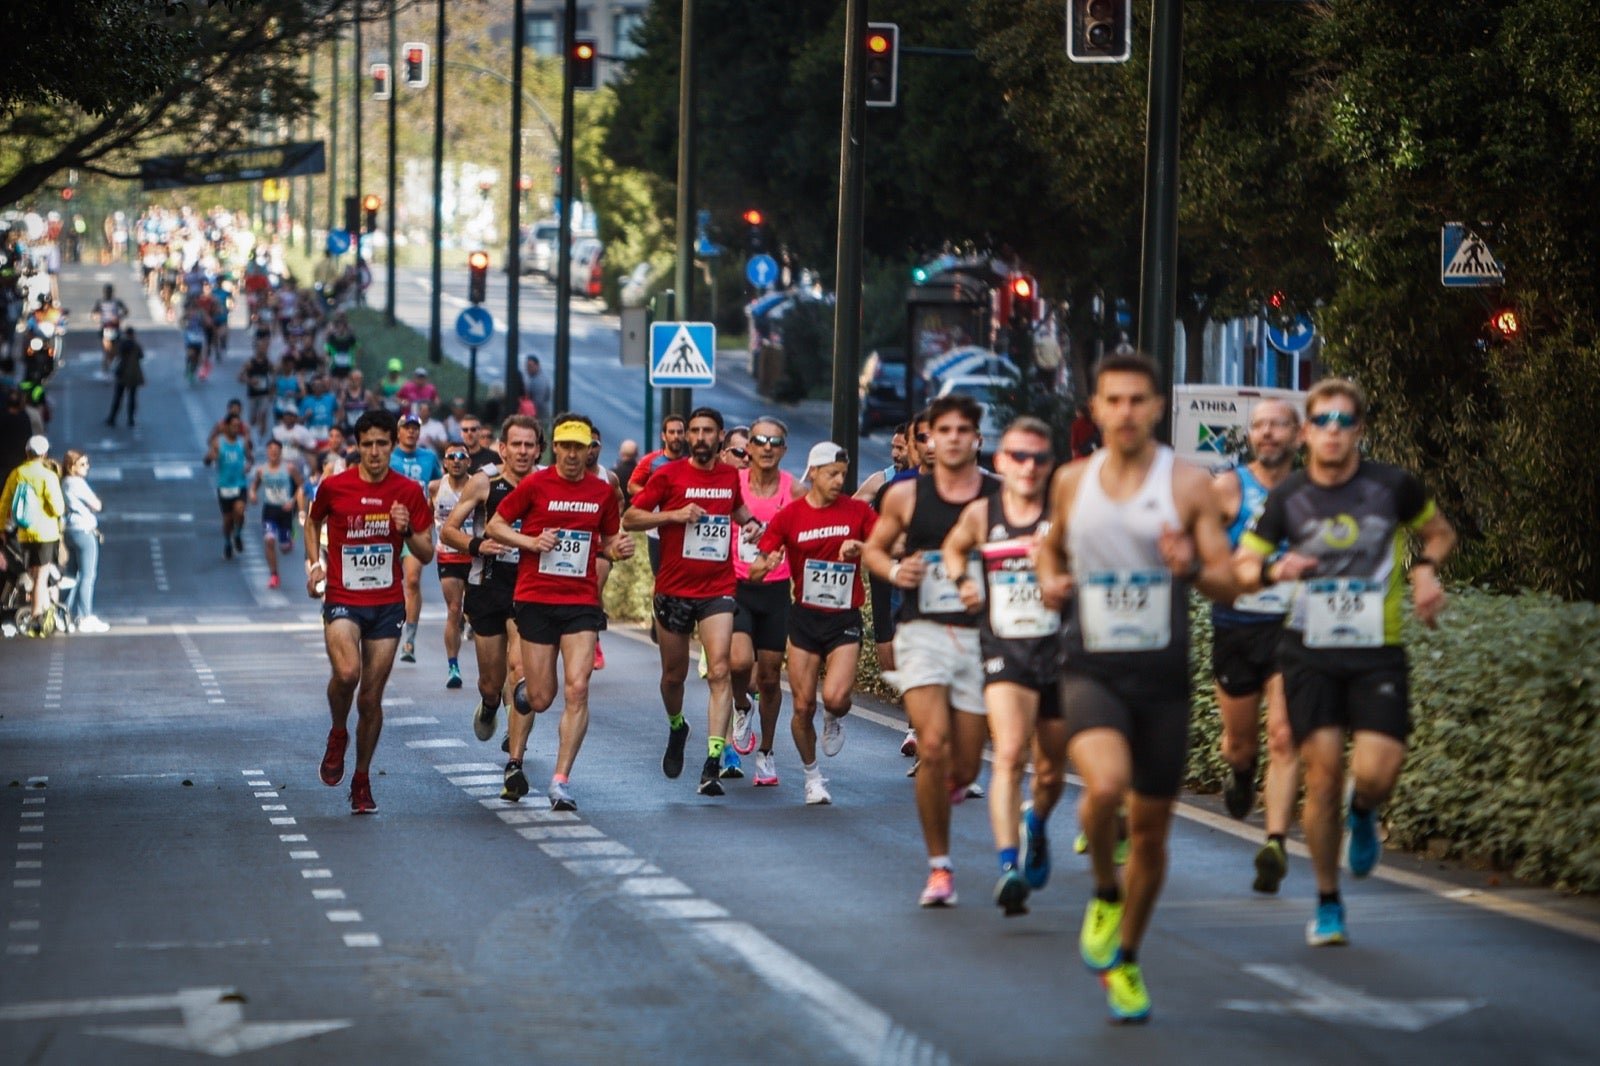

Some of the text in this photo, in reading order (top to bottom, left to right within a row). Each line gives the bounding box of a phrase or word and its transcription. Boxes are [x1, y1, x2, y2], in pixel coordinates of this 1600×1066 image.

[1190, 400, 1237, 413] ATHISA
[684, 488, 732, 499] MARCELINO
[548, 501, 599, 513] MARCELINO
[364, 520, 390, 529] PADRE
[347, 529, 390, 539] MARCELINO
[694, 525, 727, 538] 1326
[798, 525, 850, 543] MARCELINO
[555, 540, 581, 554] 538
[351, 554, 386, 568] 1406
[812, 570, 848, 586] 2110
